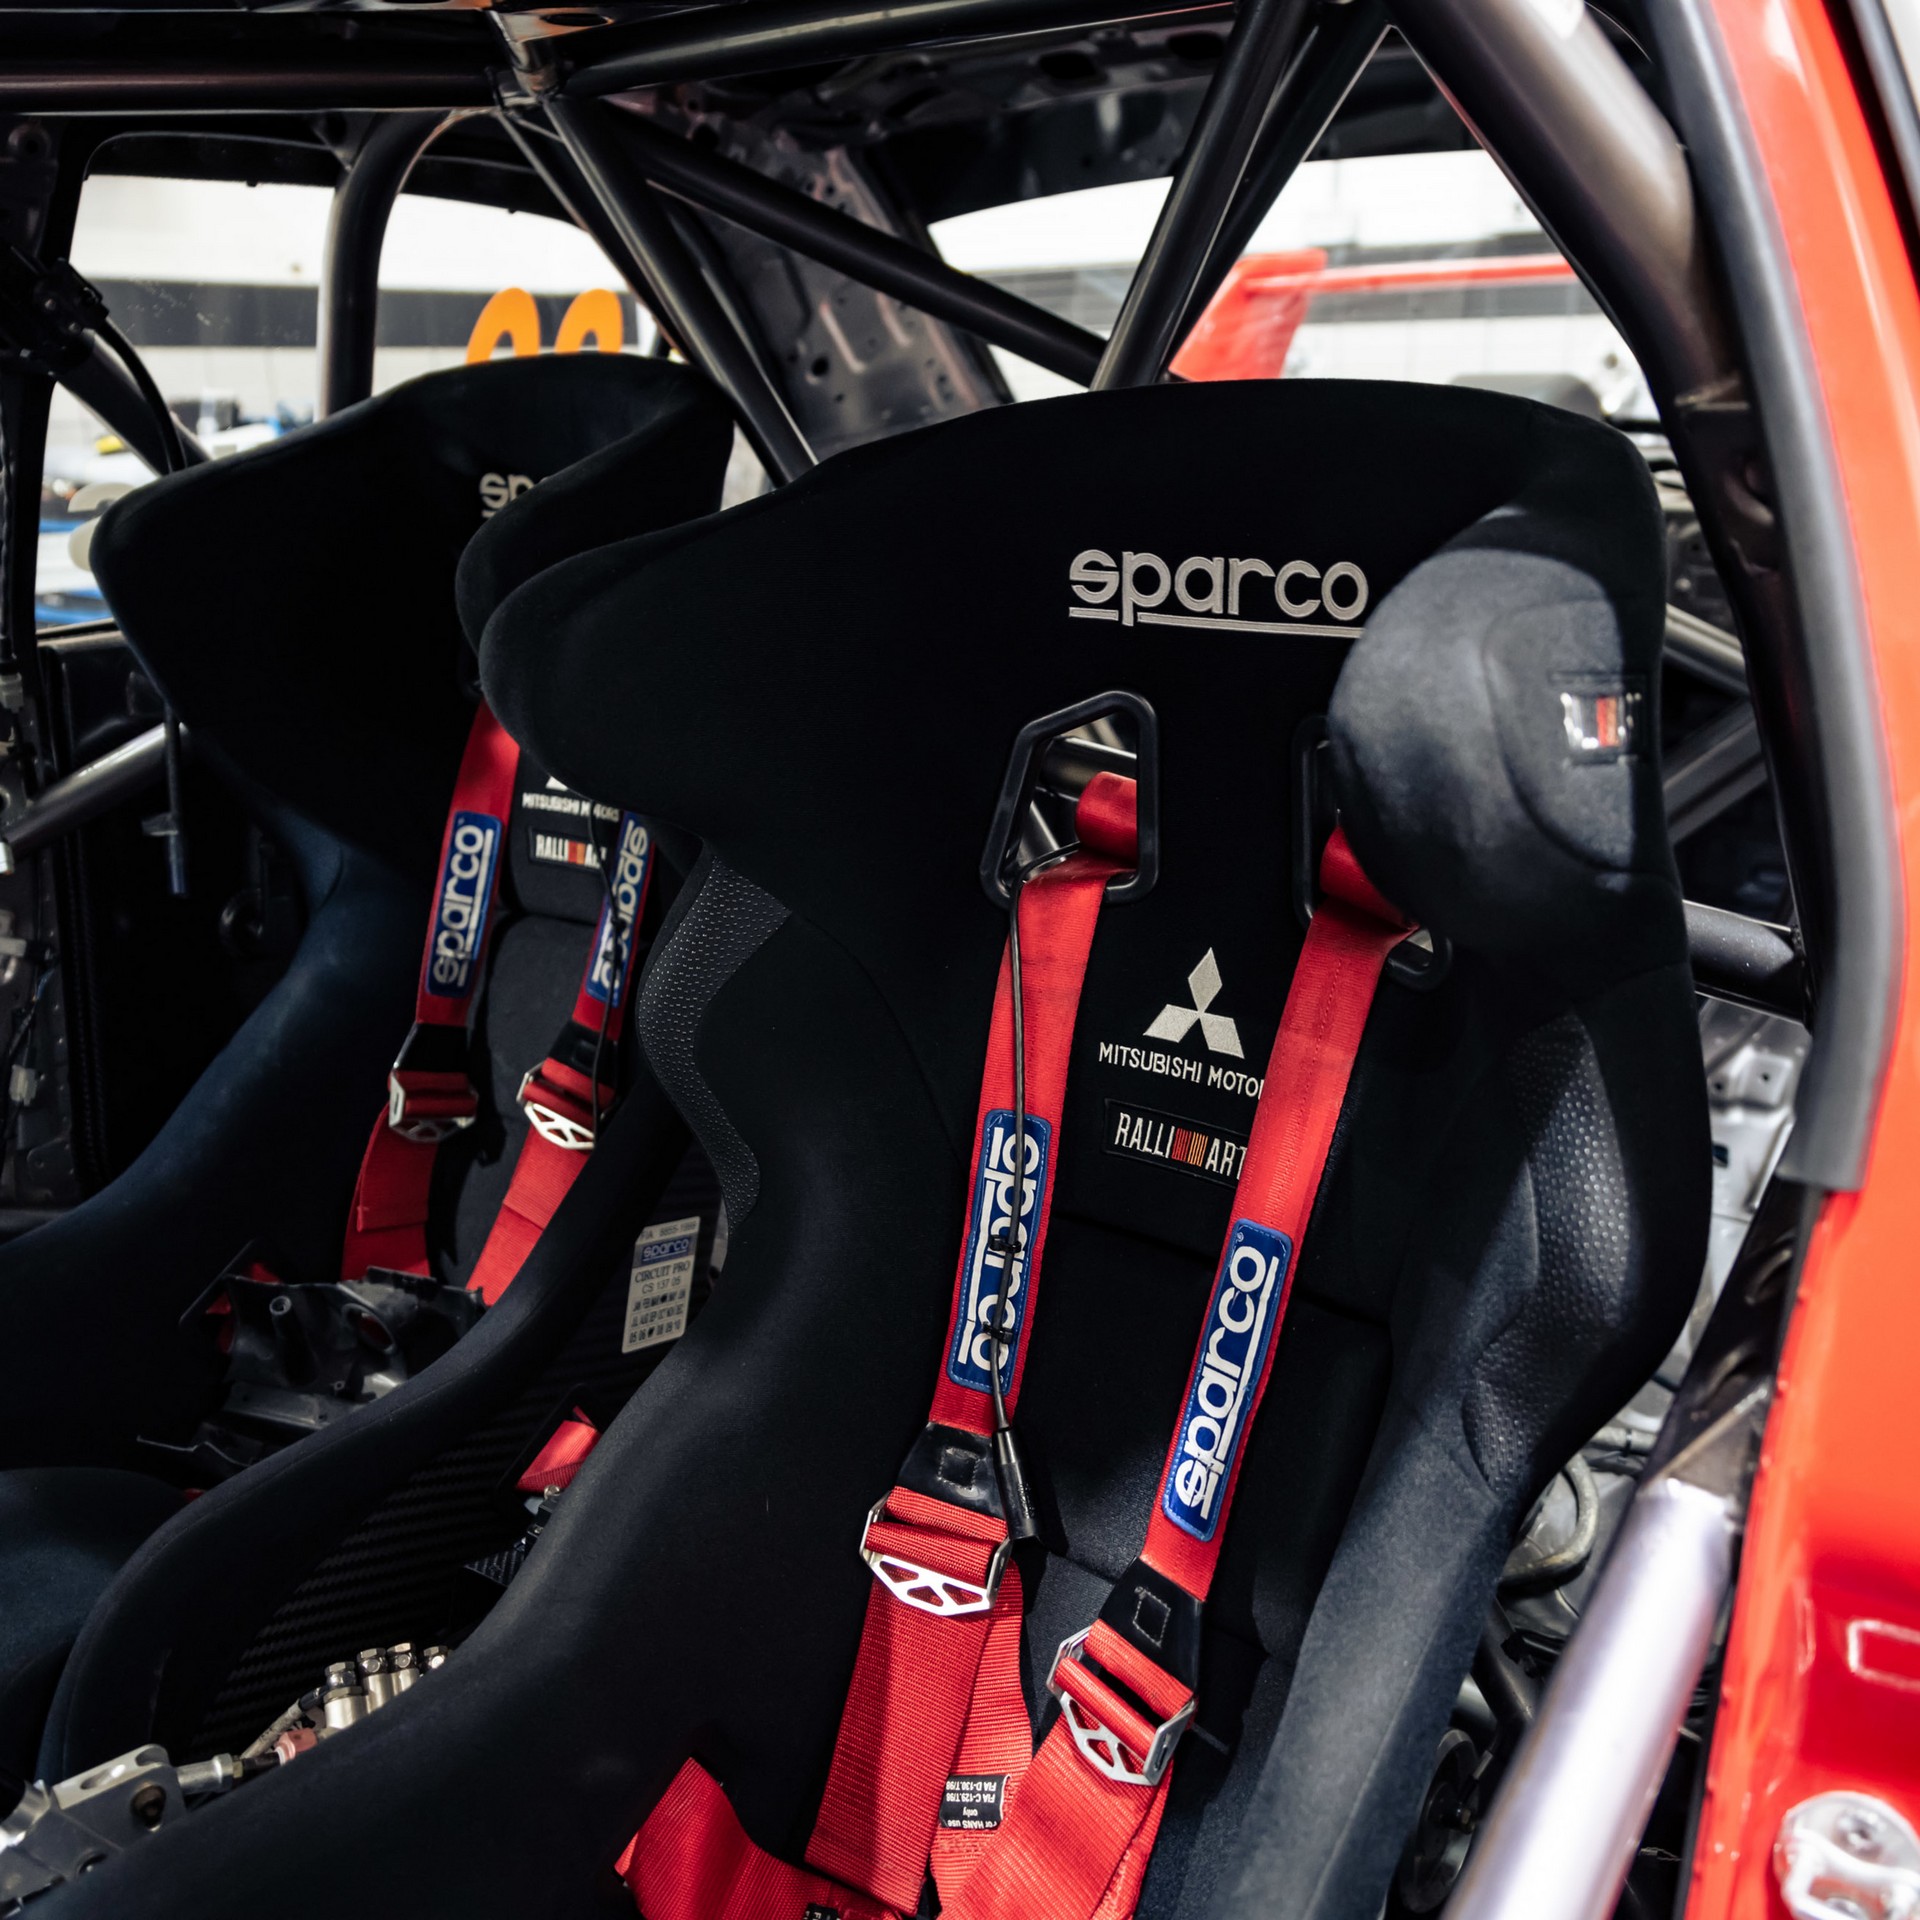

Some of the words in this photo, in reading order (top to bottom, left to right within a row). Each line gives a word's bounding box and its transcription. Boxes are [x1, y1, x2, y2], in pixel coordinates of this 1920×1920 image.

[1069, 549, 1369, 628] sparco
[522, 792, 580, 816] MITSUBISHI
[535, 834, 569, 861] RALLI
[433, 825, 486, 984] sparco
[1099, 1042, 1203, 1083] MITSUBISHI
[1207, 1065, 1264, 1100] MOTO
[1114, 1112, 1176, 1158] RALLI
[643, 1238, 689, 1258] sparco
[635, 1265, 671, 1283] CIRCUIT
[672, 1260, 690, 1274] PRO
[1175, 1246, 1267, 1508] sparco
[984, 1781, 997, 1791] FIA
[983, 1793, 996, 1803] FIA
[947, 1819, 961, 1827] use
[962, 1806, 978, 1818] only
[962, 1819, 985, 1829] HANS
